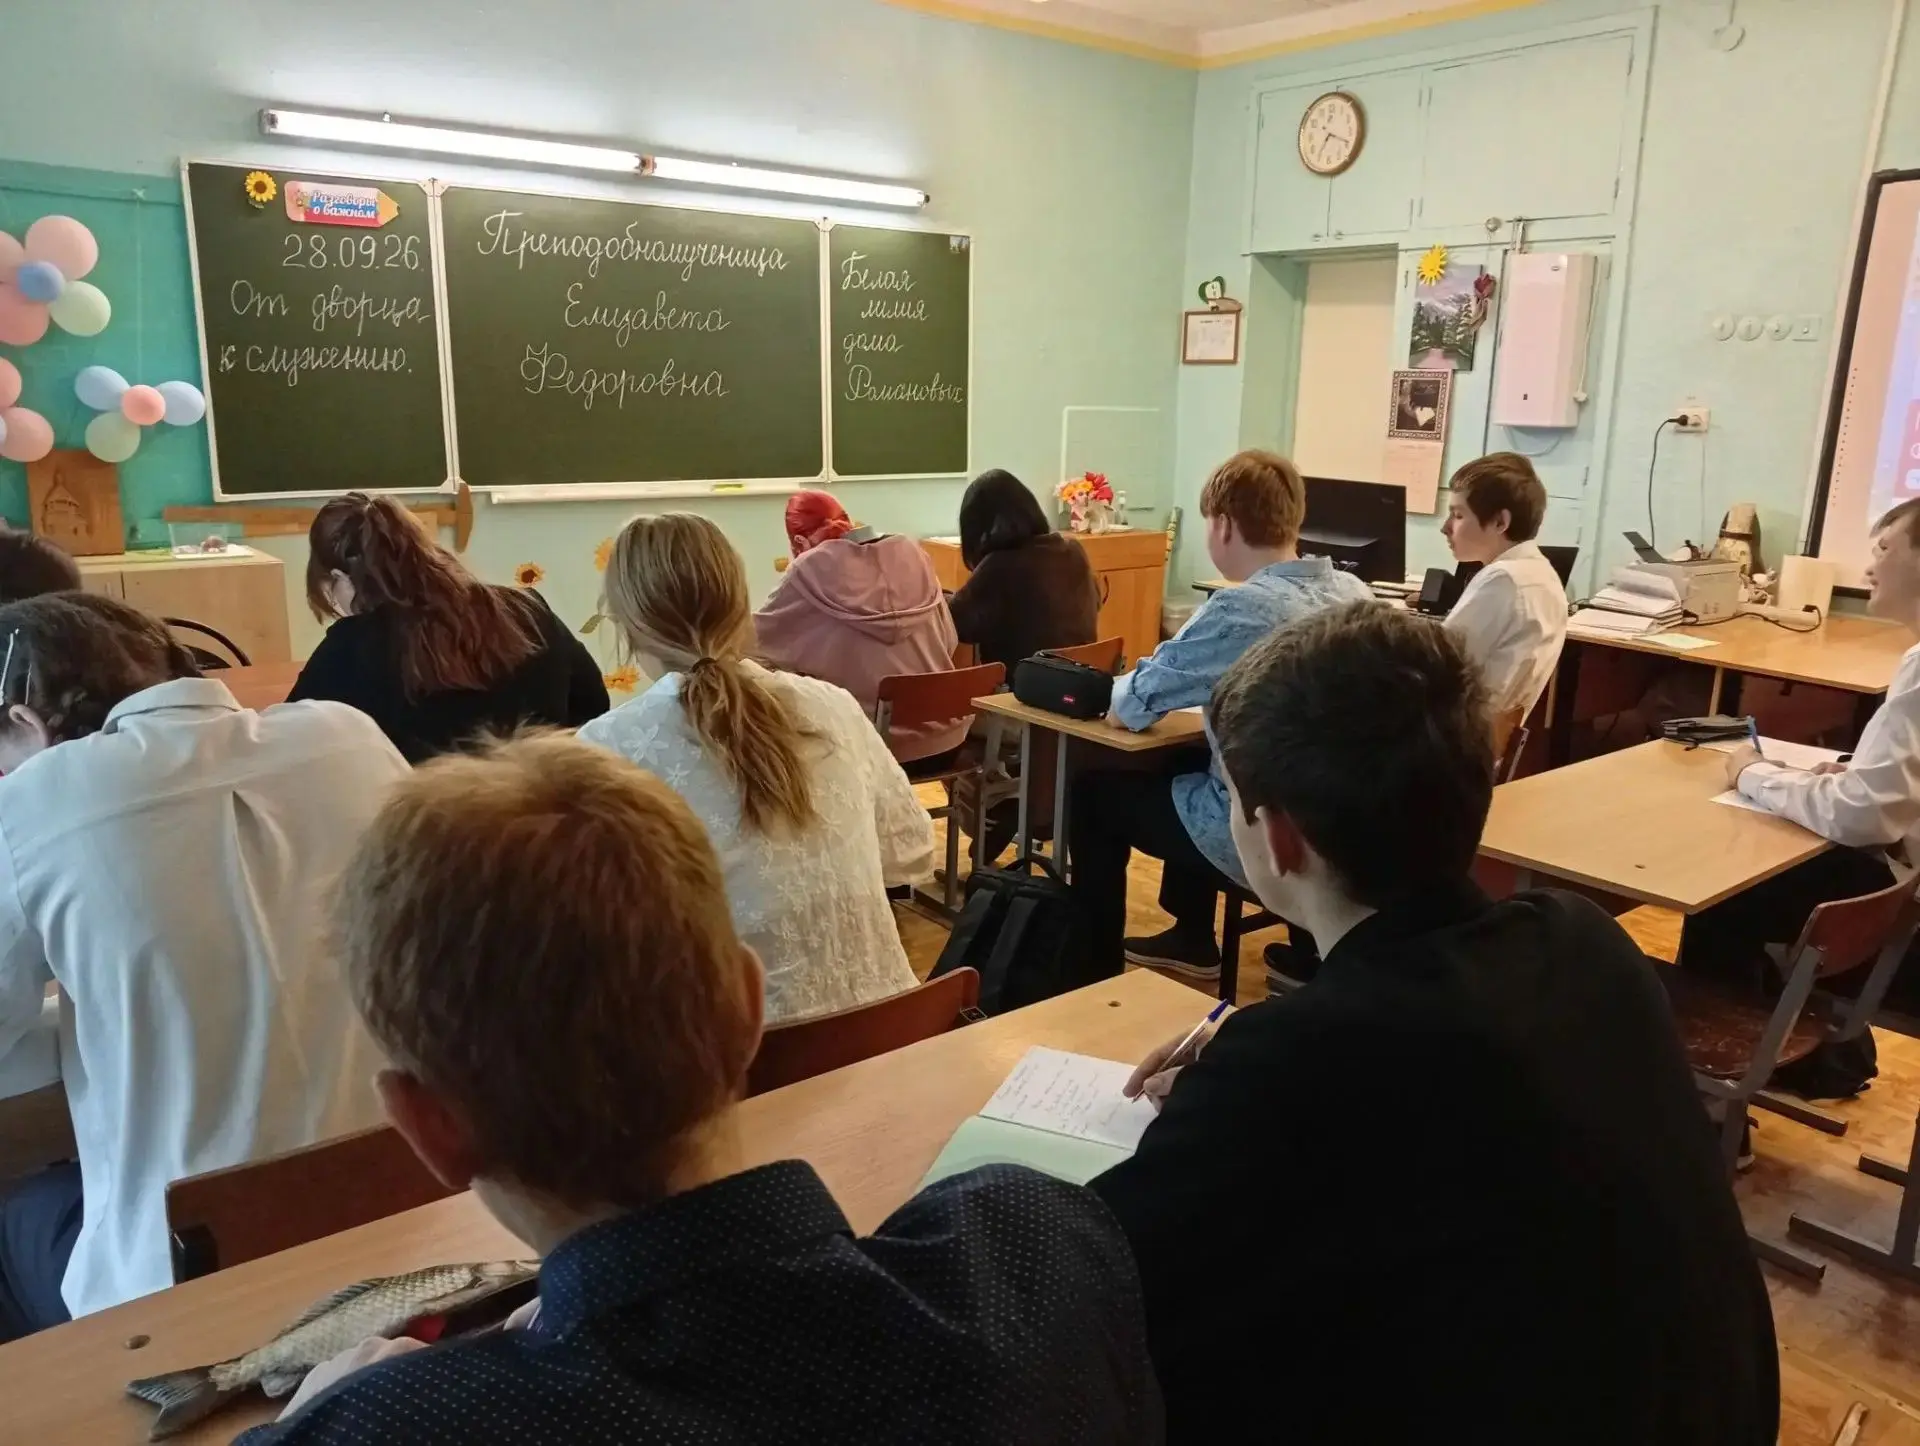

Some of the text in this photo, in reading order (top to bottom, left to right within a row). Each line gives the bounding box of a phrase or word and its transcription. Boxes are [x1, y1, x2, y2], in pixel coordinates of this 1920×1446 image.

[312, 189, 376, 209] Разговоры
[313, 203, 377, 219] о важном
[841, 250, 918, 292] Белая
[230, 279, 431, 337] От дворца
[564, 282, 731, 348] Елизавета
[861, 299, 930, 321] лилия
[843, 332, 905, 365] дома
[520, 342, 731, 410] Федоровна
